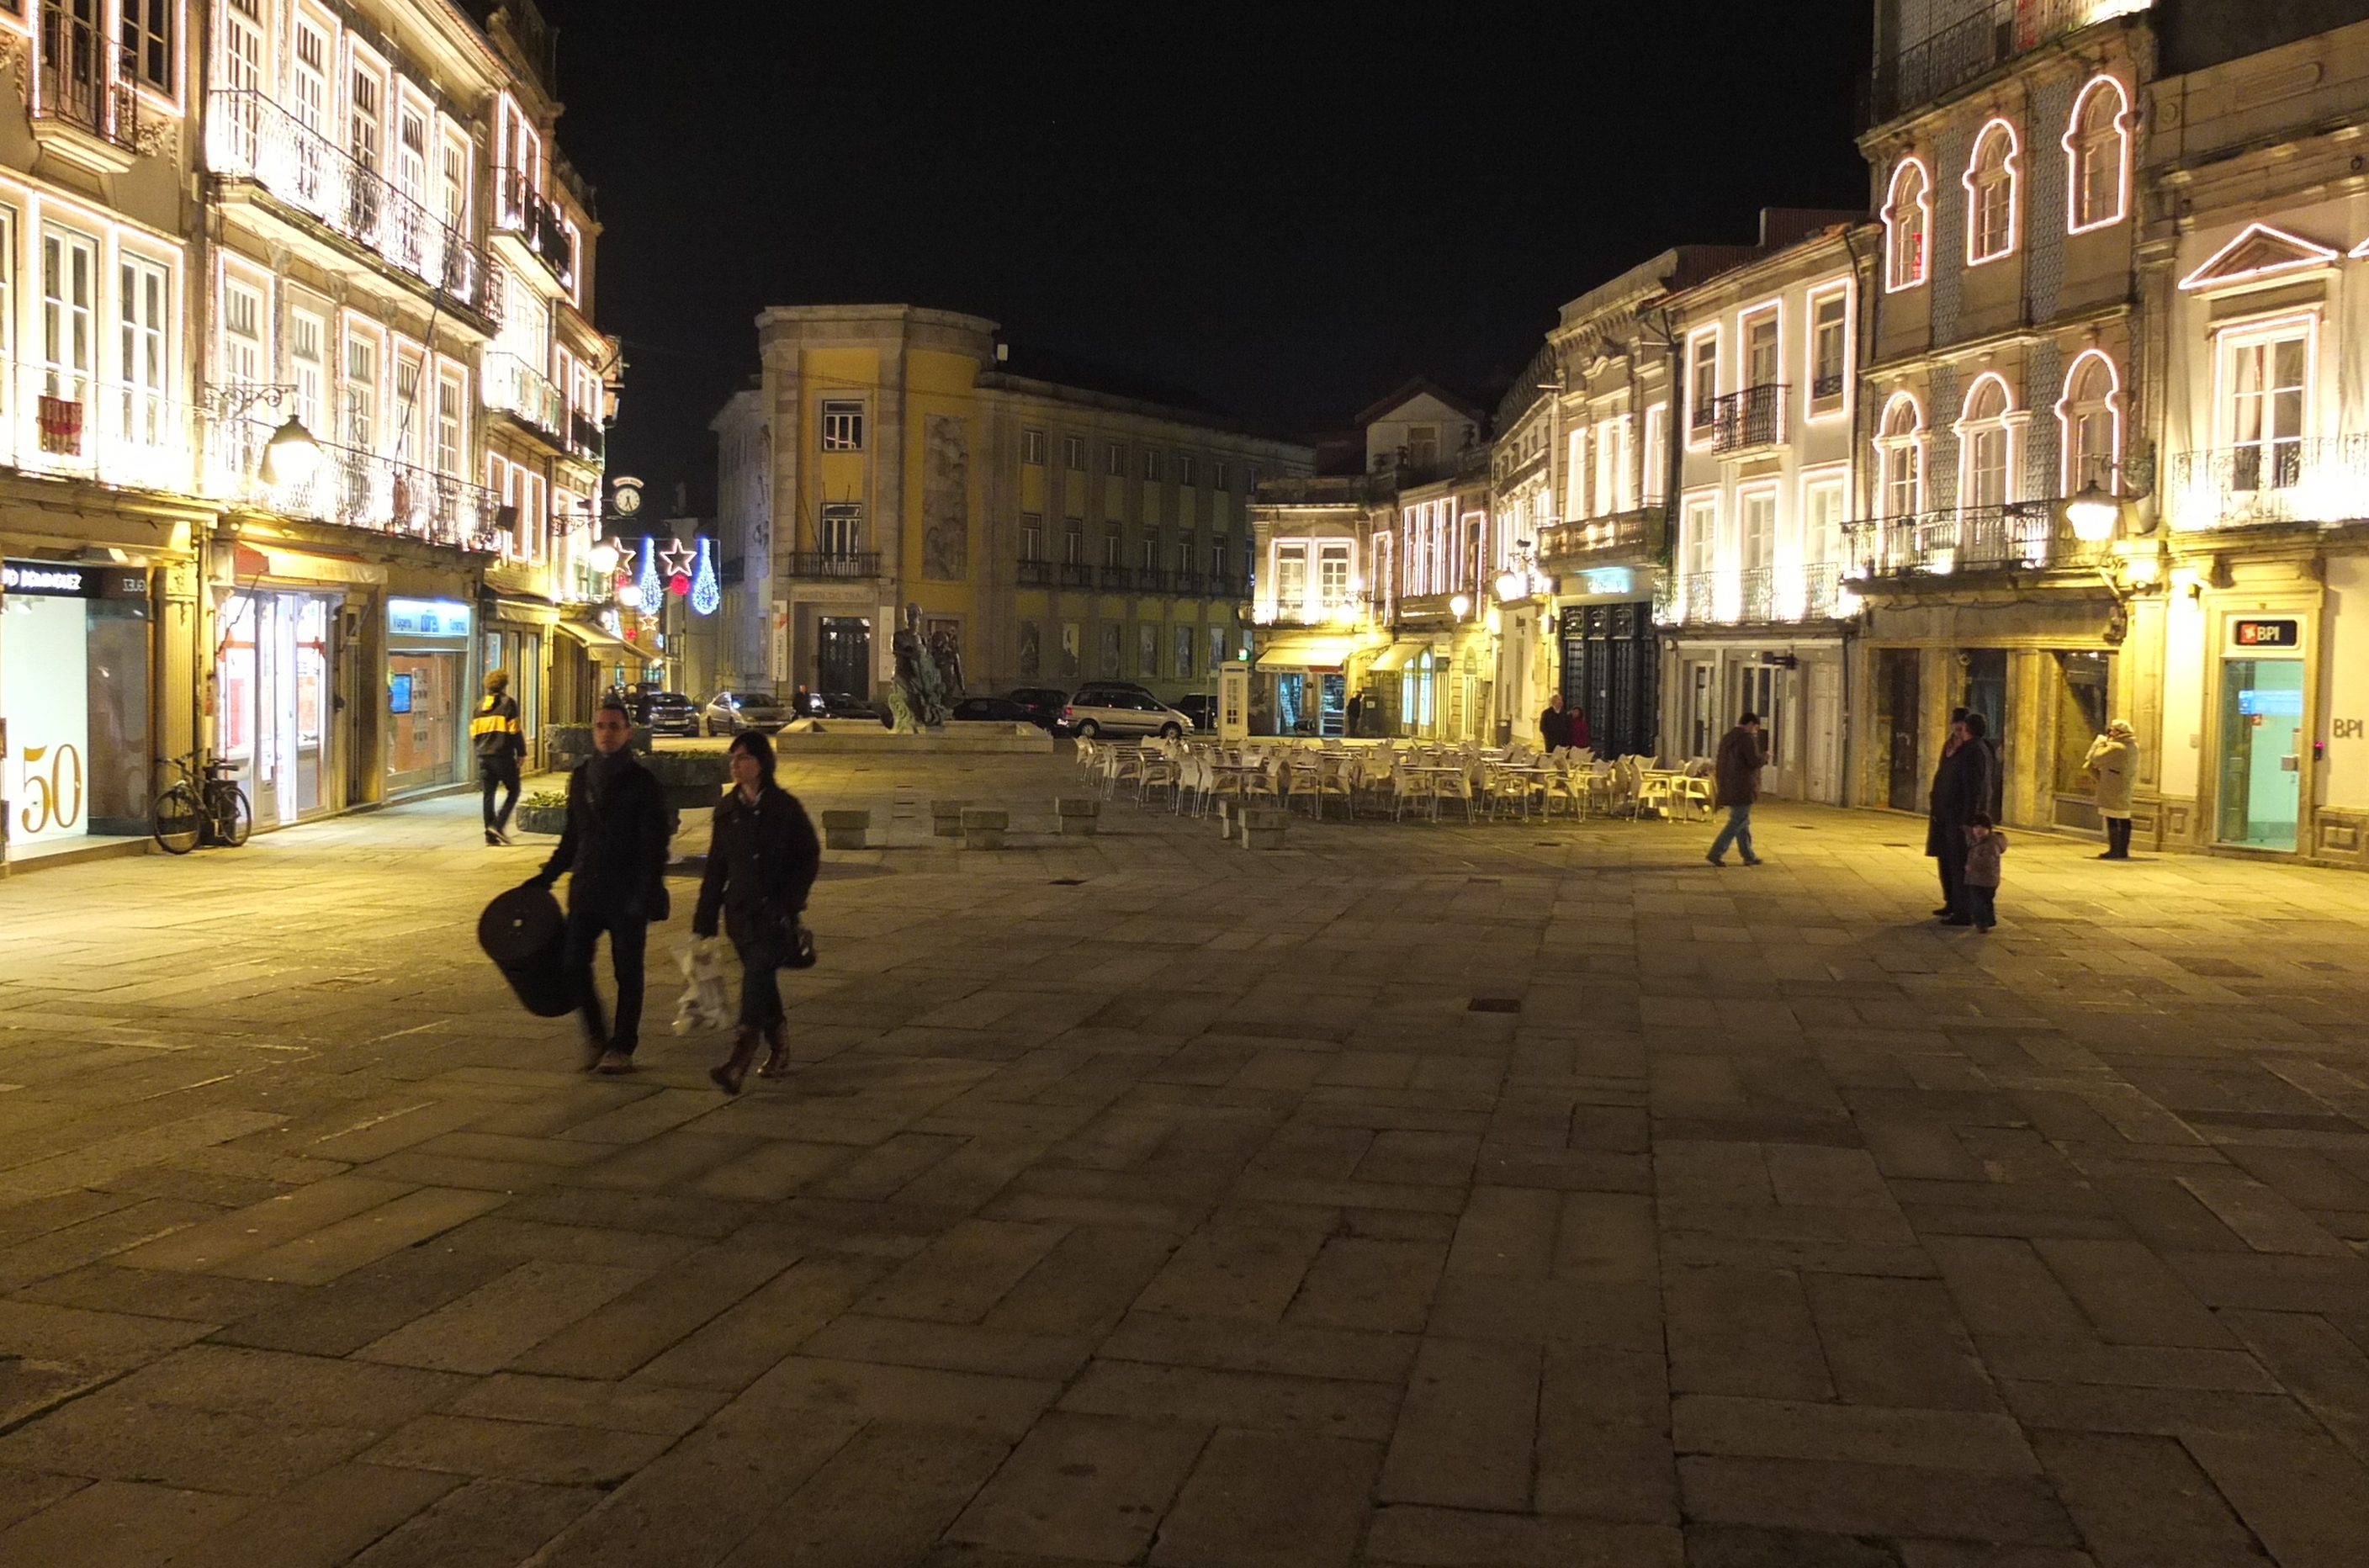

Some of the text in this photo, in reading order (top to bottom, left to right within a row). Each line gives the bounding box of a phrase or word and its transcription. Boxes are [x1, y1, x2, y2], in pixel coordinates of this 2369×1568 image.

[2257, 626, 2280, 641] BPI
[2333, 718, 2363, 739] BPI
[22, 744, 82, 834] 50
